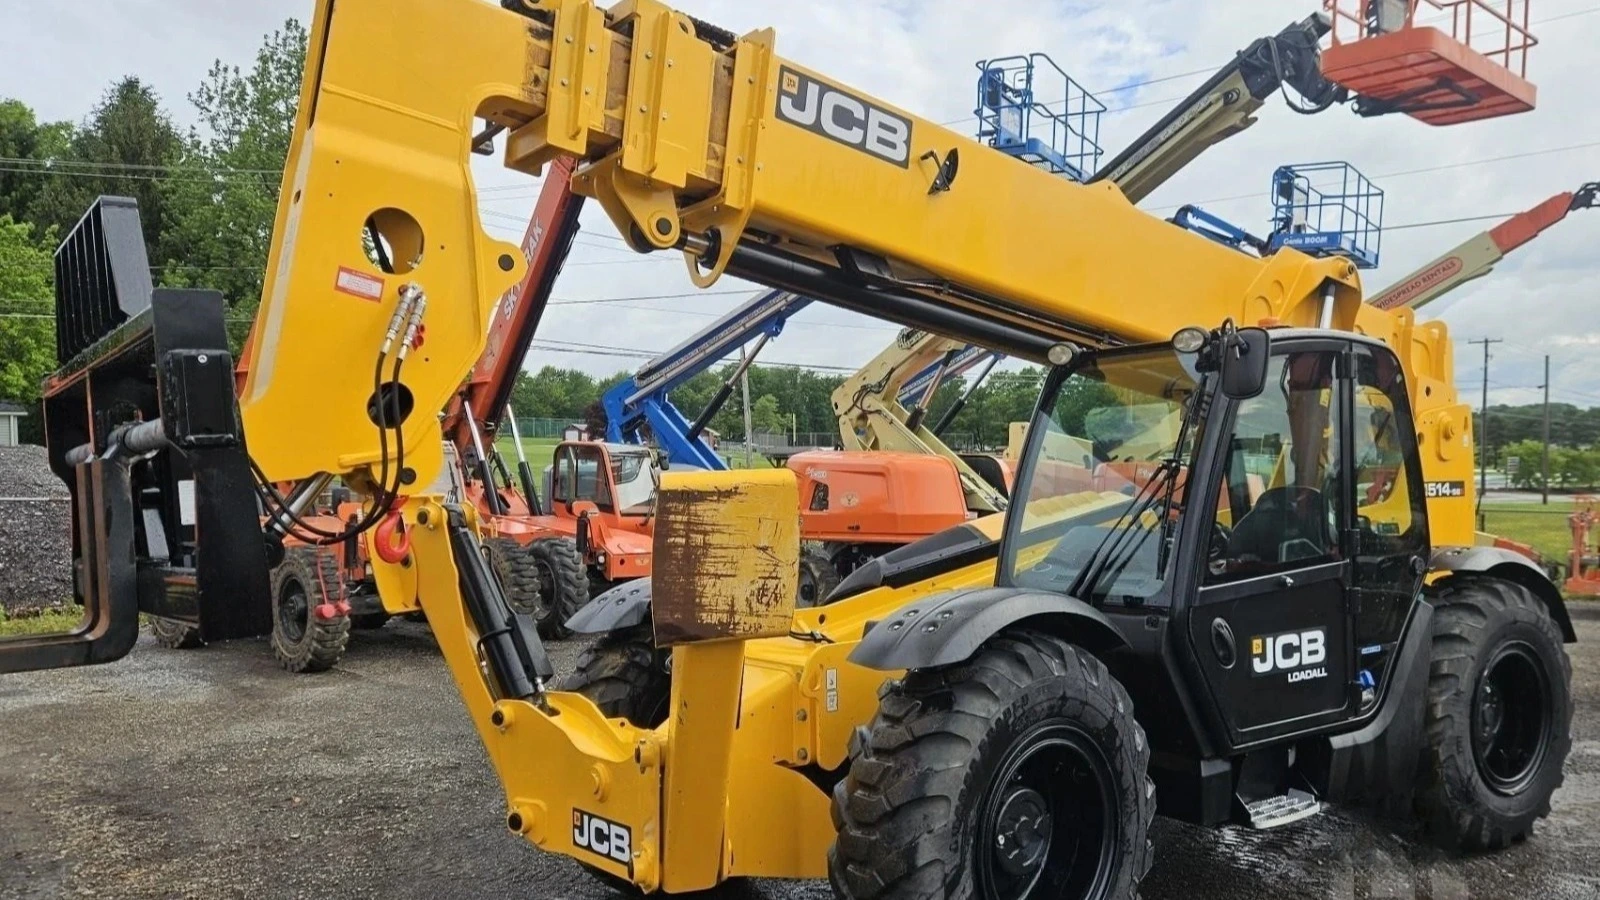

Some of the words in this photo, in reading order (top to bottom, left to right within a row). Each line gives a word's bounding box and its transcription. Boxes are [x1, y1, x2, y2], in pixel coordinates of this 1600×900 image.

[780, 81, 908, 162] JCB
[1422, 260, 1456, 283] RENTALS
[1252, 629, 1326, 673] JCB
[1287, 667, 1327, 683] LOADALL
[574, 814, 631, 863] JCB
